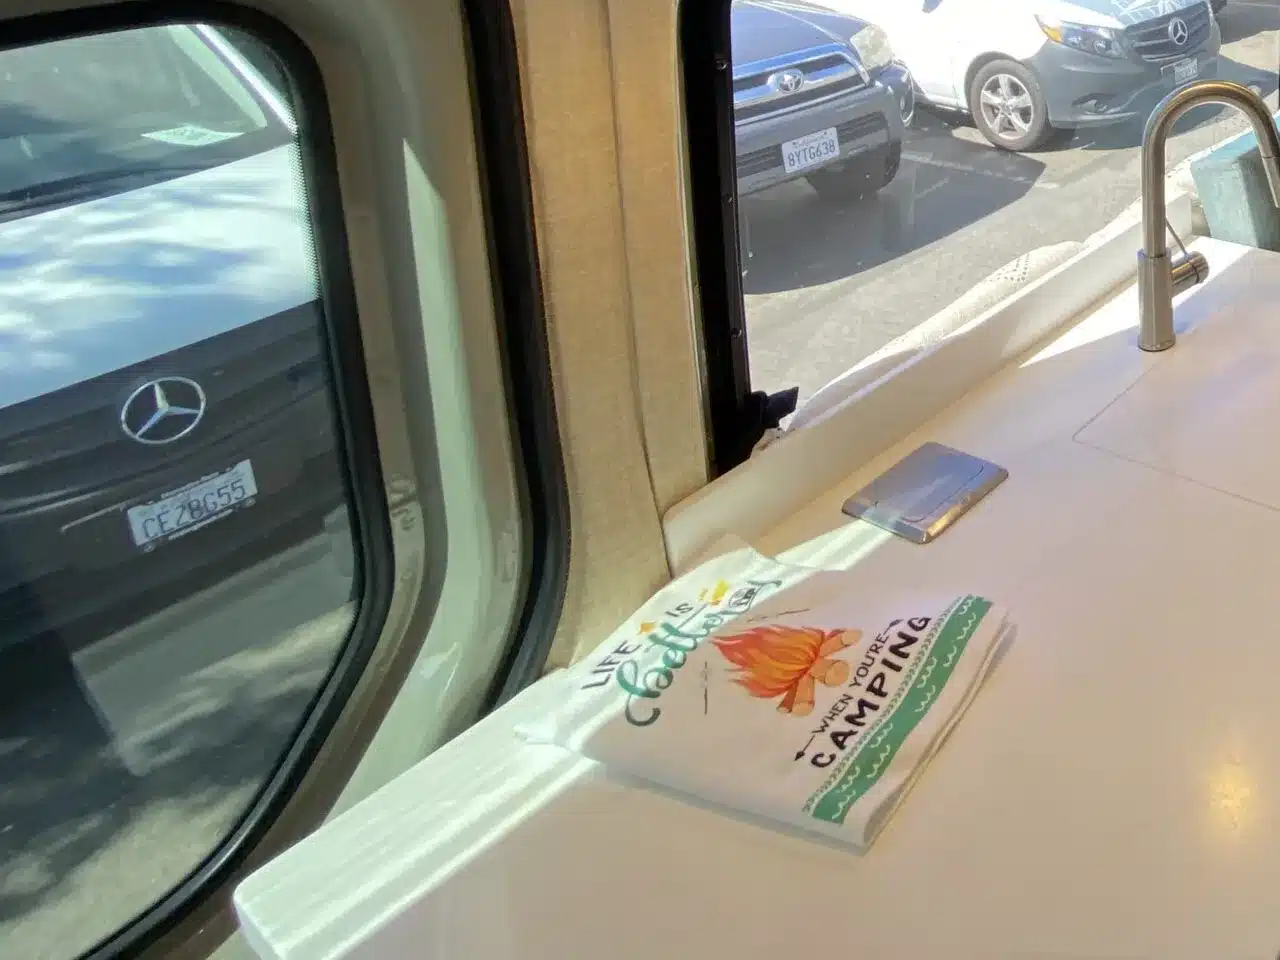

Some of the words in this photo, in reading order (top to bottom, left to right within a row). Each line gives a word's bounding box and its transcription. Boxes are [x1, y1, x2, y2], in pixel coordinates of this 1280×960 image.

[581, 640, 642, 690] LIFE
[810, 616, 933, 768] CAMPING
[811, 693, 854, 734] WHEN
[848, 632, 890, 688] YOU'RE
